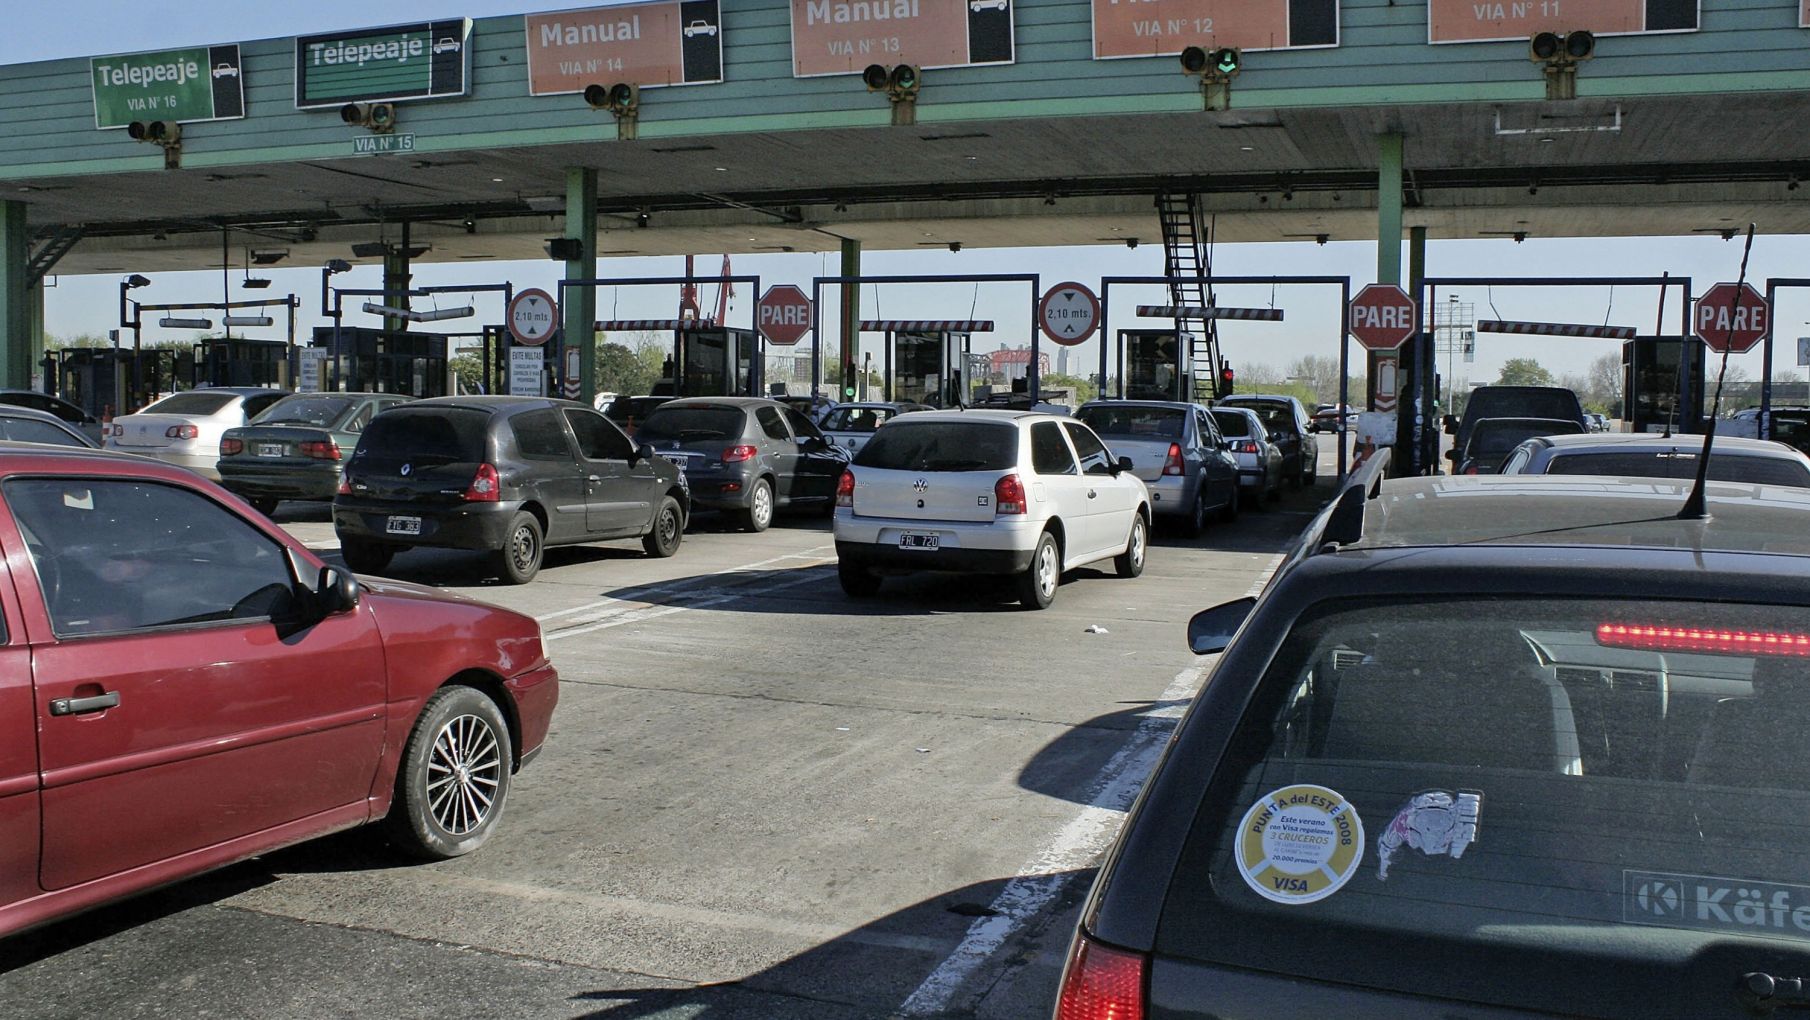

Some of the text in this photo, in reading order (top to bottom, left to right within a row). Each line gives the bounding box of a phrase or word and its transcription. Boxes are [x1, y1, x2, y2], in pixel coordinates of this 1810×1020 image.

[806, 0, 920, 26] Manual
[1473, 4, 1505, 20] VIA
[1540, 1, 1560, 17] 11
[540, 15, 640, 48] Manual
[1133, 20, 1162, 36] VIA
[1194, 18, 1213, 33] 12
[310, 34, 422, 66] Telepeaje
[827, 41, 854, 56] VIA
[882, 38, 900, 52] 13
[98, 58, 198, 88] Telepeaje
[560, 62, 582, 76] VIA
[607, 58, 624, 72] 14
[128, 98, 146, 111] VIA
[164, 96, 176, 108] 16
[356, 138, 376, 151] VIA
[399, 136, 412, 149] 15
[760, 304, 808, 325] PARE
[1072, 308, 1091, 318] mts.
[1353, 306, 1411, 328] PARE
[1700, 305, 1764, 331] PARE
[900, 535, 938, 547] FRL 720
[1252, 794, 1352, 846] PUNTA del ESTE 2008
[1280, 816, 1326, 826] Este verano
[1270, 832, 1329, 845] 3 CRUCEROS
[1282, 824, 1299, 832] Visa
[1300, 828, 1334, 836] regalamos
[1272, 876, 1308, 892] VISA
